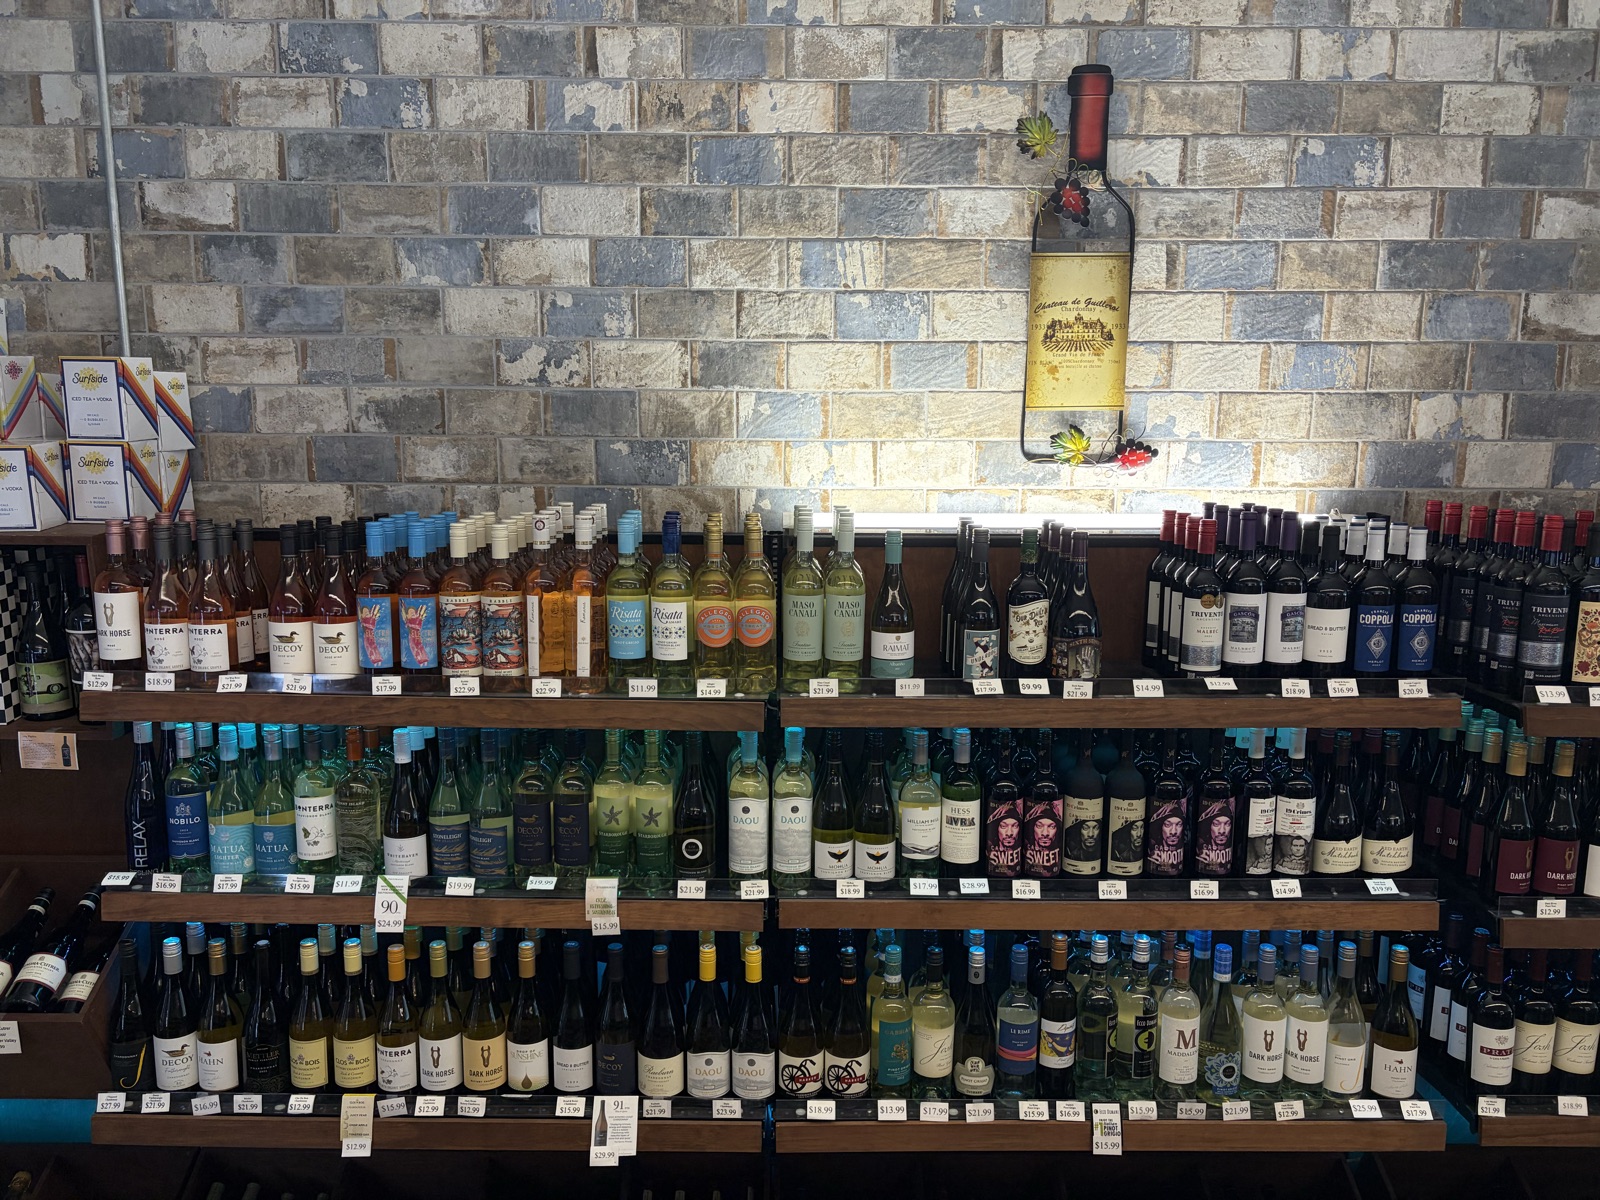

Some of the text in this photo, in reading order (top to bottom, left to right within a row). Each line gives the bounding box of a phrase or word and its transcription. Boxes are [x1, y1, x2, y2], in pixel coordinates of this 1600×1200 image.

[1034, 299, 1069, 314] Chateau
[72, 372, 108, 385] Surfside
[78, 457, 114, 469] Surfside
[792, 601, 815, 609] MASO
[838, 601, 860, 609] MASO
[611, 607, 642, 622] Risata
[653, 607, 683, 622] Risata
[701, 609, 732, 621] ALLEGRO
[739, 609, 770, 621] ALLEGRO
[789, 609, 818, 617] CANALI
[834, 609, 862, 617] CANALI
[147, 678, 172, 686] $18.99
[951, 807, 971, 815] HESS
[170, 817, 201, 825] NOBILO
[733, 816, 759, 825] DAOU
[781, 816, 807, 824] DAOU
[132, 820, 148, 868] RELAX
[255, 844, 289, 853] MATUA
[211, 845, 245, 853] MATUA
[989, 851, 1021, 866] SWEET
[1026, 849, 1060, 866] SWEET
[1510, 872, 1526, 880] DARK
[1547, 872, 1565, 880] DARK
[448, 882, 472, 890] $19.99
[913, 882, 938, 890] $17.99
[381, 900, 399, 915] 90
[1174, 1028, 1197, 1049] M
[1554, 1033, 1595, 1057] Josh
[511, 1050, 544, 1060] SUNSHINE
[1249, 1051, 1283, 1062] DARK HORSE
[1300, 1055, 1320, 1063] HORSE
[162, 1054, 194, 1066] DECOY
[199, 1056, 224, 1065] HAHN
[355, 1057, 370, 1065] BOIS
[422, 1068, 455, 1077] DARK HORSE
[485, 1066, 503, 1075] HORSE
[695, 1067, 722, 1076] DAOU
[738, 1068, 766, 1076] DAOU
[1384, 1064, 1413, 1073] HAHN
[101, 1102, 121, 1110] $27.99
[194, 1102, 218, 1112] $16.99
[381, 1103, 405, 1112] $15.99
[613, 1100, 624, 1110] 91
[923, 1108, 948, 1116] $17.99
[1095, 1142, 1120, 1150] $15.99
